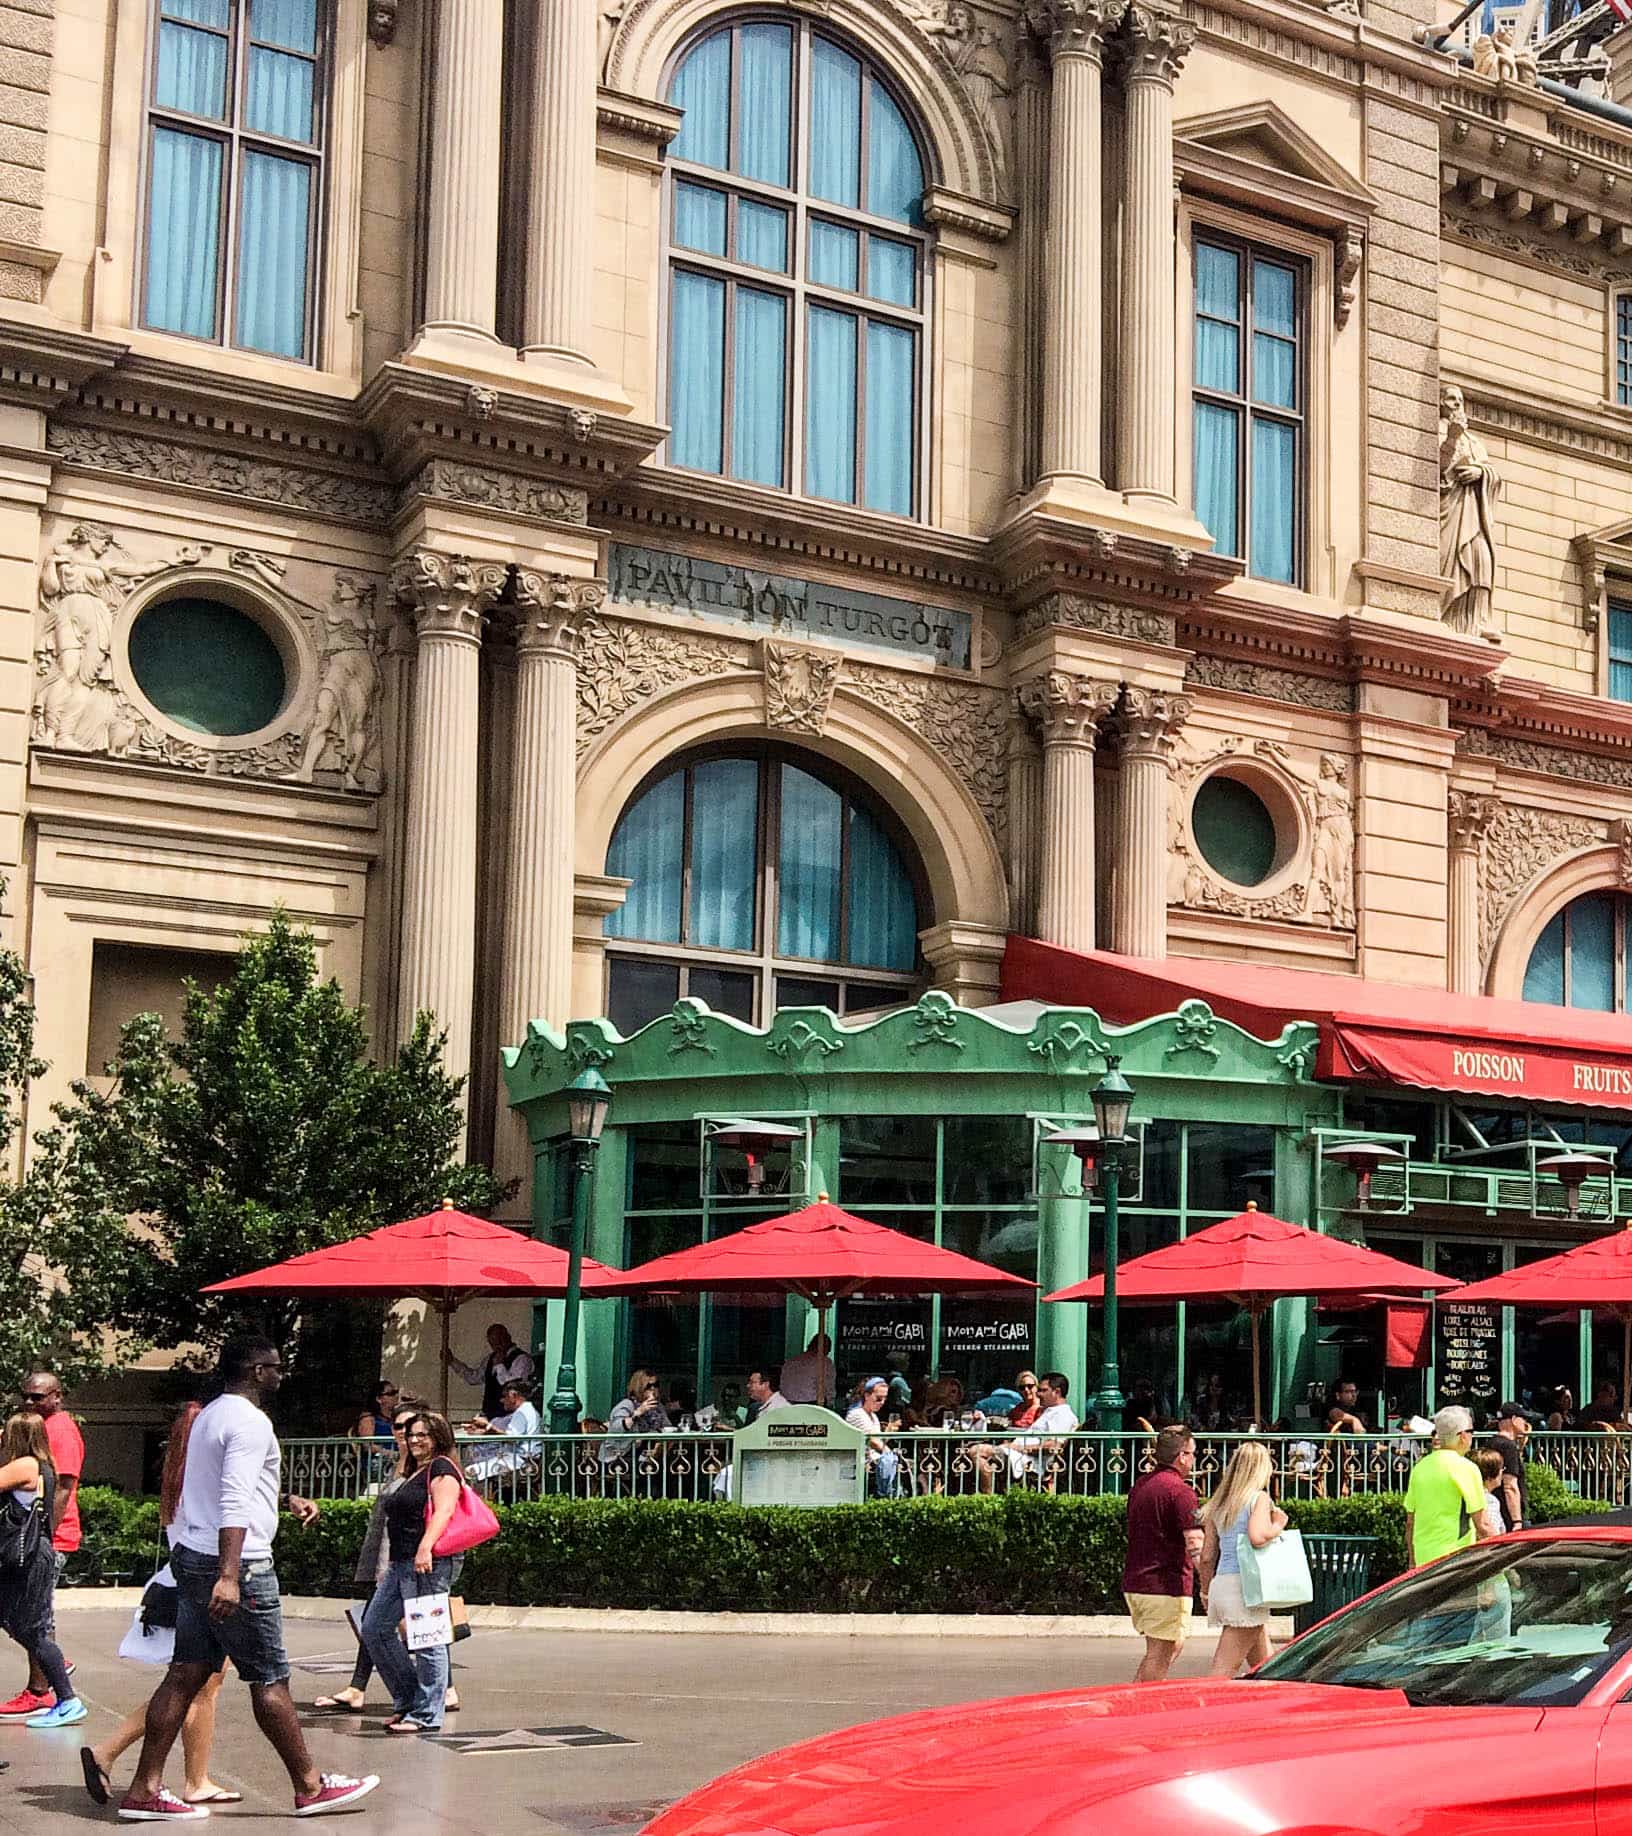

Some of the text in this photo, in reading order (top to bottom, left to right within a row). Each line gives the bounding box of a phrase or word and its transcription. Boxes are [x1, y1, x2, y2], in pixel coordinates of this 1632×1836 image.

[815, 601, 954, 650] TURGOT
[1453, 1050, 1525, 1084] POISSON
[1572, 1064, 1632, 1095] FRUITS
[894, 1322, 925, 1340] GABI
[999, 1322, 1029, 1340] GABI
